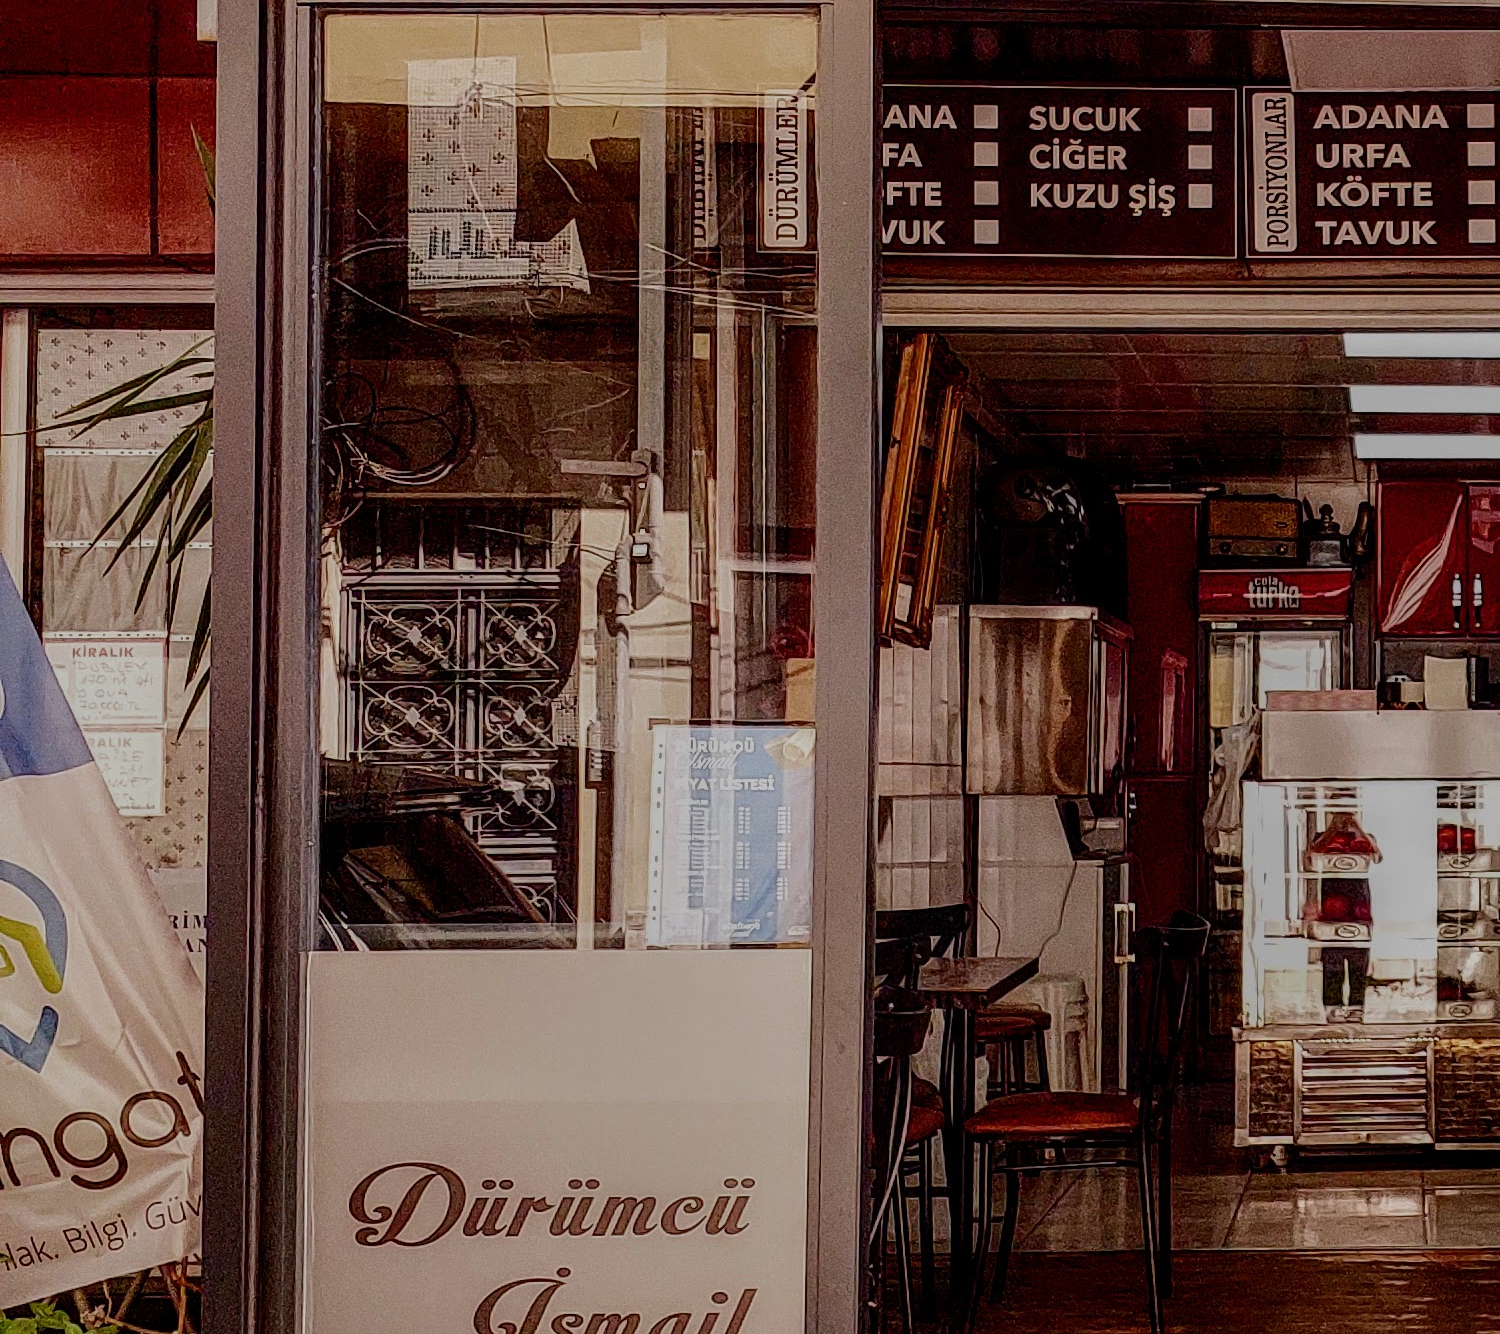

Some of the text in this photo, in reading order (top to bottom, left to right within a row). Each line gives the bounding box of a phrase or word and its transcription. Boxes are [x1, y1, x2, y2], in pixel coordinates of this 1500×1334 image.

[882, 104, 958, 130] ANA
[1028, 106, 1142, 132] SUCUK
[1312, 104, 1450, 130] ADANA
[768, 94, 799, 241] DÜRÜMLER
[1028, 138, 1128, 171] CİĞER
[1315, 143, 1412, 169] URFA
[1258, 97, 1289, 248] PORSİYONLAR
[882, 181, 943, 207] FTE
[1030, 178, 1177, 218] KUZU ŞİŞ
[1315, 175, 1434, 208] KÖFTE
[1314, 220, 1438, 245] TAVUK
[1254, 575, 1279, 586] cola
[1248, 581, 1300, 609] turka
[72, 645, 134, 658] KİRALIK
[347, 1161, 757, 1248] Dürümcü
[0, 1236, 60, 1272] lak.
[63, 1213, 137, 1254] Bilgi.
